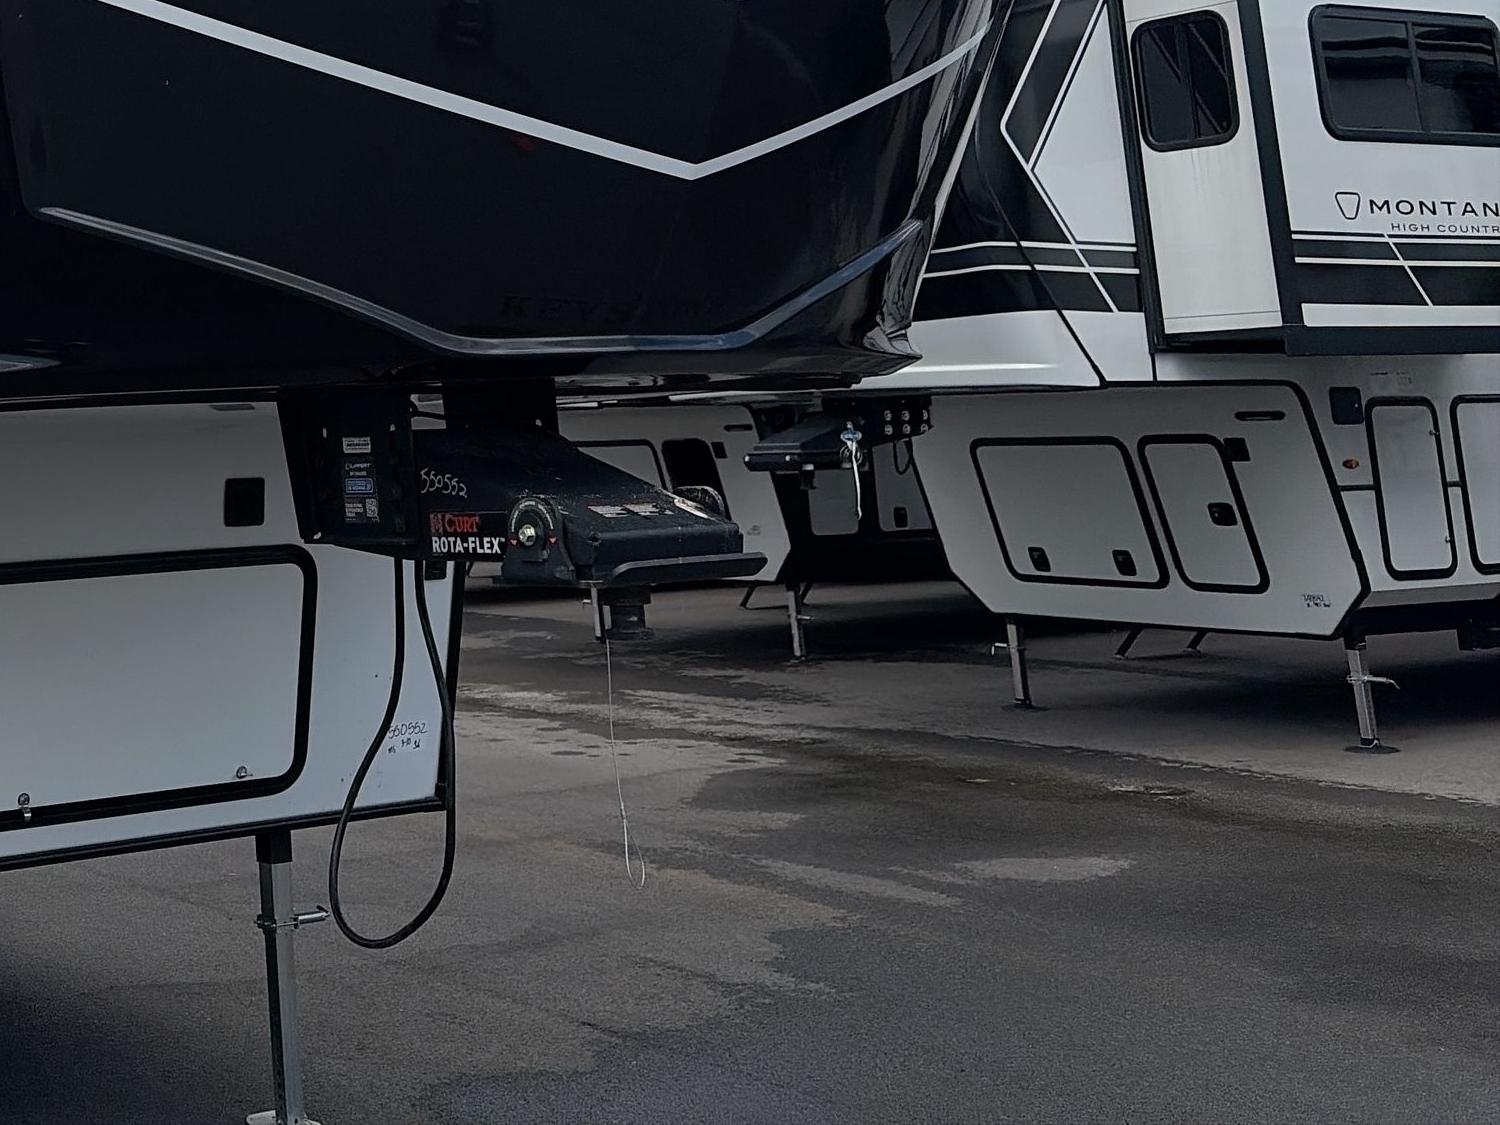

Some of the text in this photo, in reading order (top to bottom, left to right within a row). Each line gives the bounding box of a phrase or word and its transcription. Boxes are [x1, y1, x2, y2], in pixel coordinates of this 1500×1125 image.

[1369, 199, 1500, 217] MONTAN
[1391, 223, 1500, 234] HIGH COUNTR
[420, 468, 468, 499] 550552
[445, 515, 481, 533] CURT
